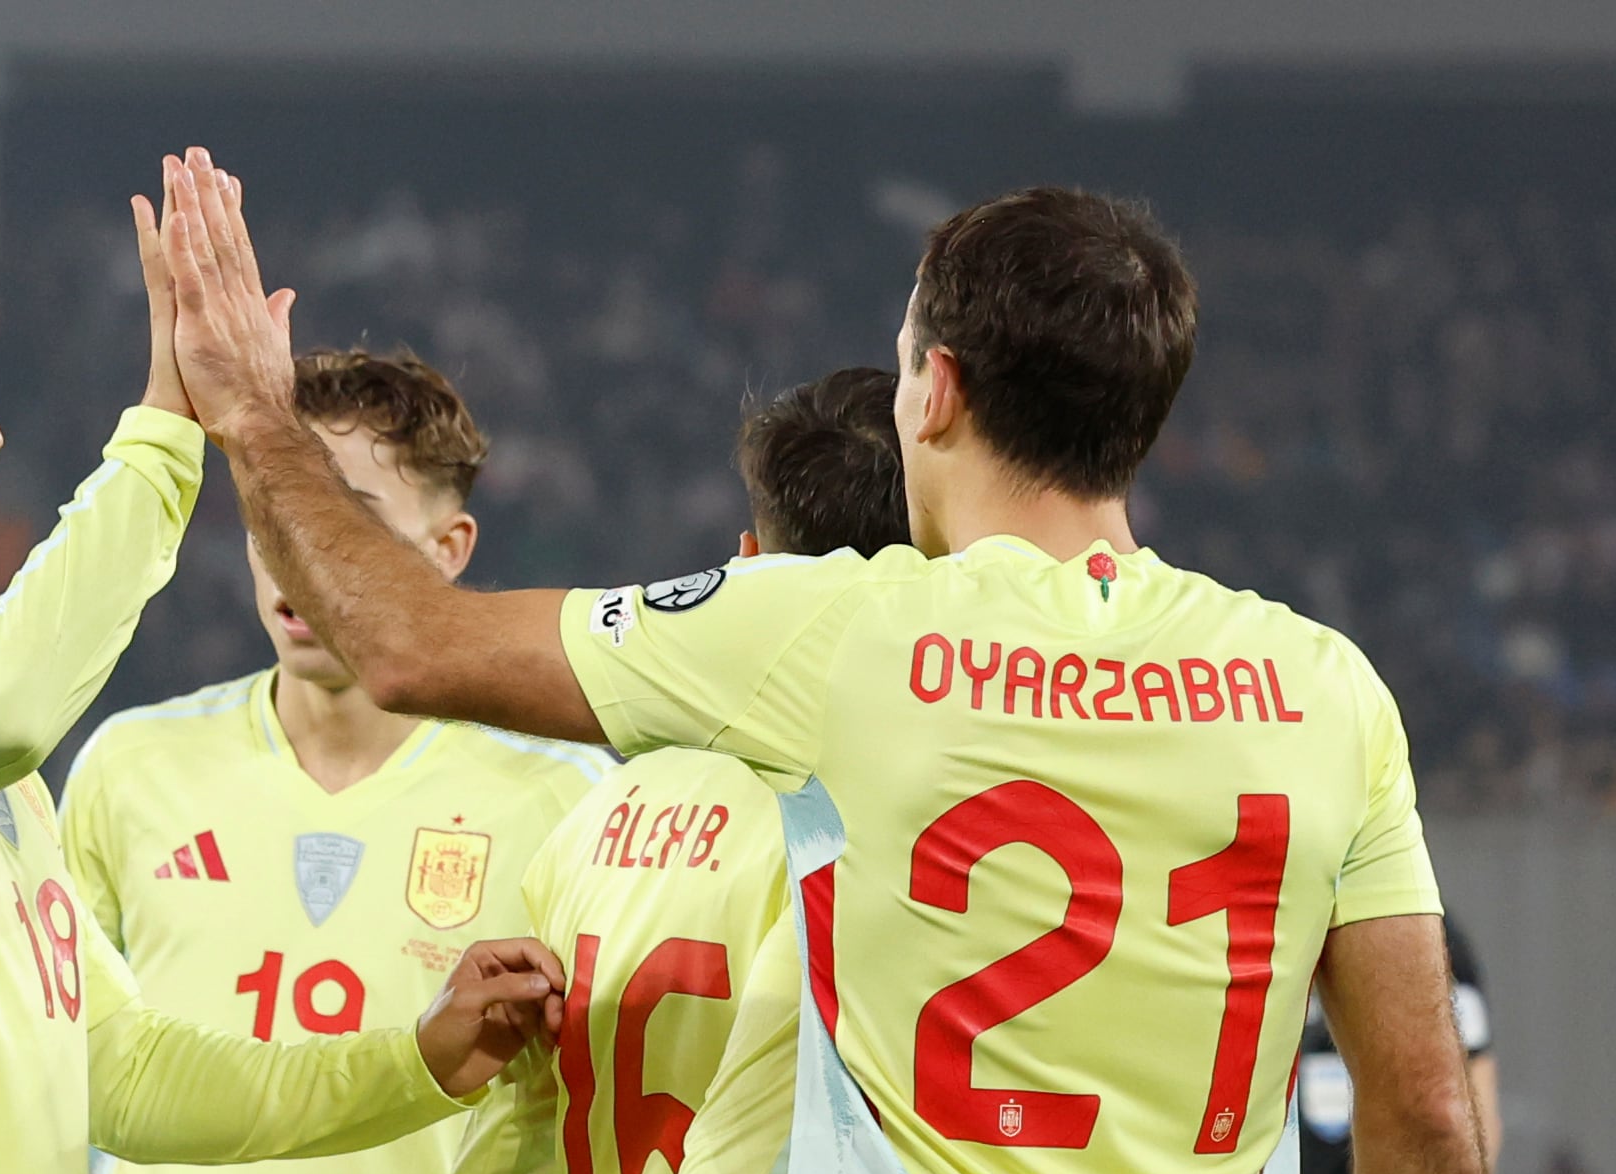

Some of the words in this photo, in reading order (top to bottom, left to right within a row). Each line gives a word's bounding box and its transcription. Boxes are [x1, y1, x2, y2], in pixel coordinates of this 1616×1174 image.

[909, 632, 1304, 723] OYARZABAL
[688, 804, 730, 872] B.
[11, 878, 81, 1023] 18
[907, 779, 1290, 1155] 21
